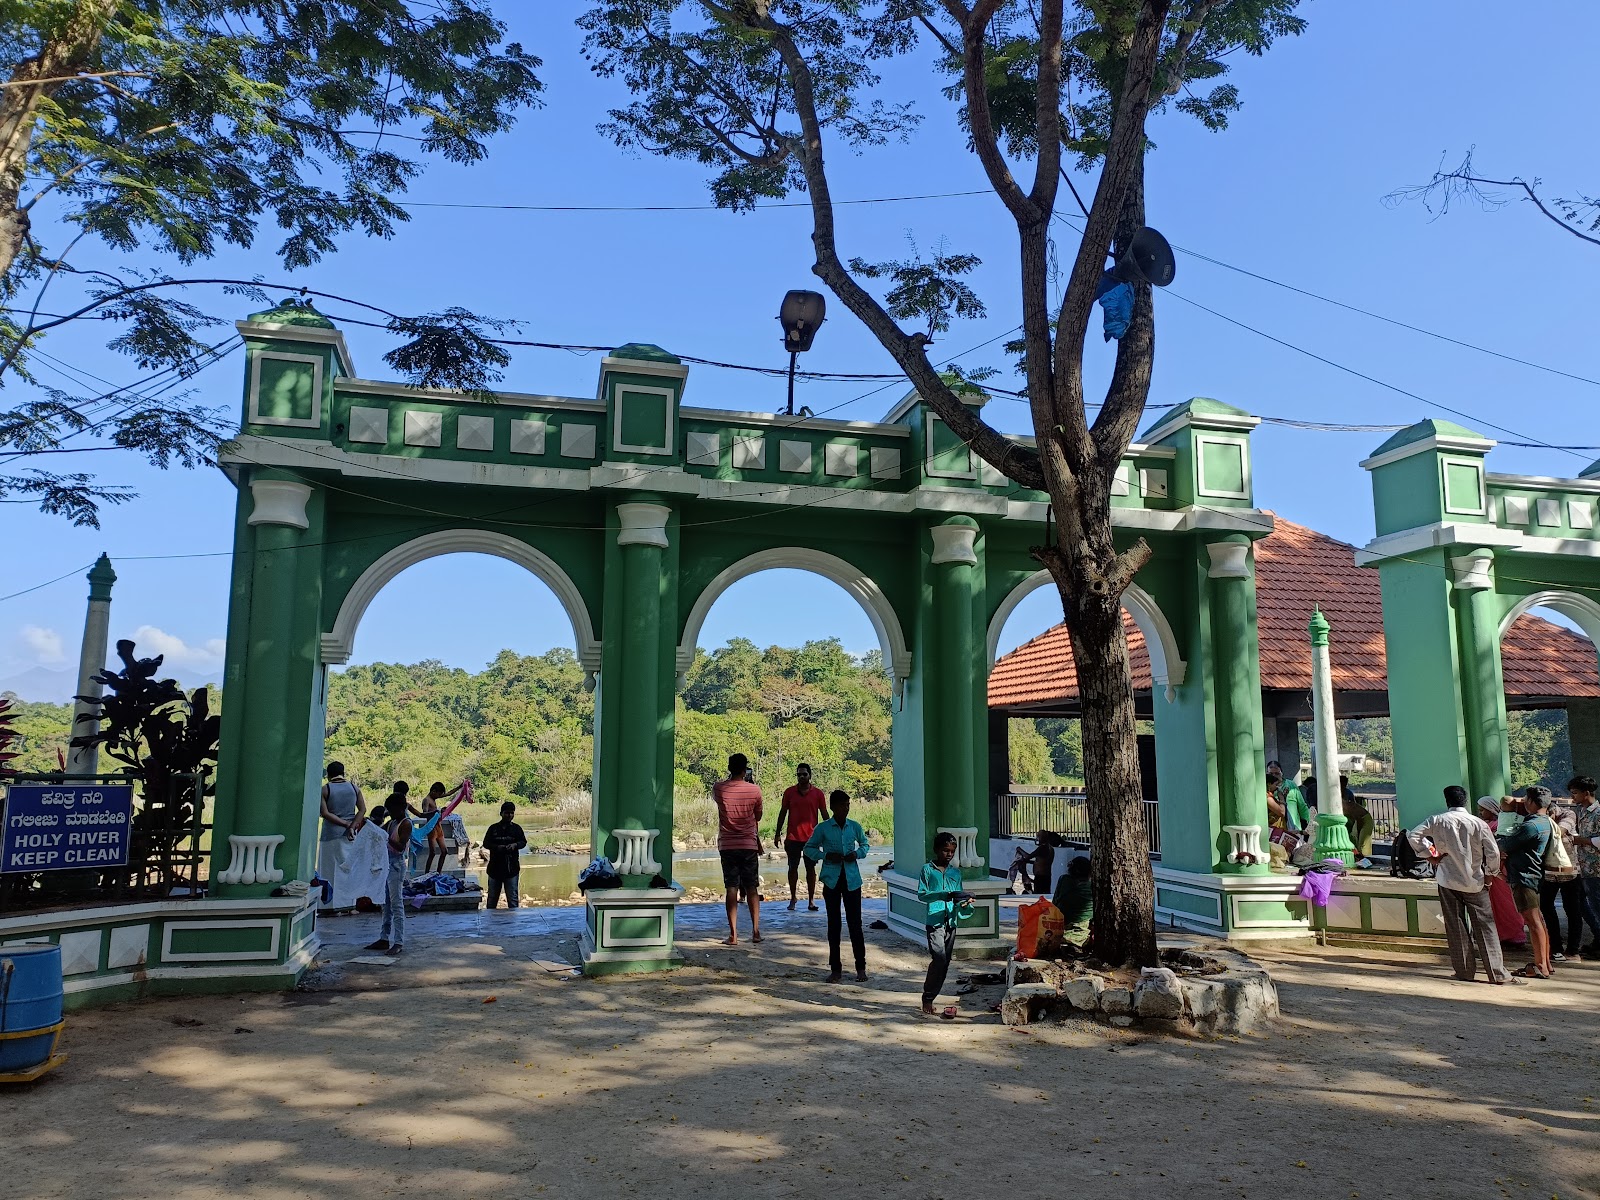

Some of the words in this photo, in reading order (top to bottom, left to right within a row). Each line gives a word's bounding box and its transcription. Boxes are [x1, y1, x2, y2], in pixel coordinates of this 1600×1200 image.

[15, 834, 63, 847] HOLY
[69, 832, 119, 845] RIVER
[11, 851, 58, 865] KEEP
[65, 846, 119, 862] CLEAN
